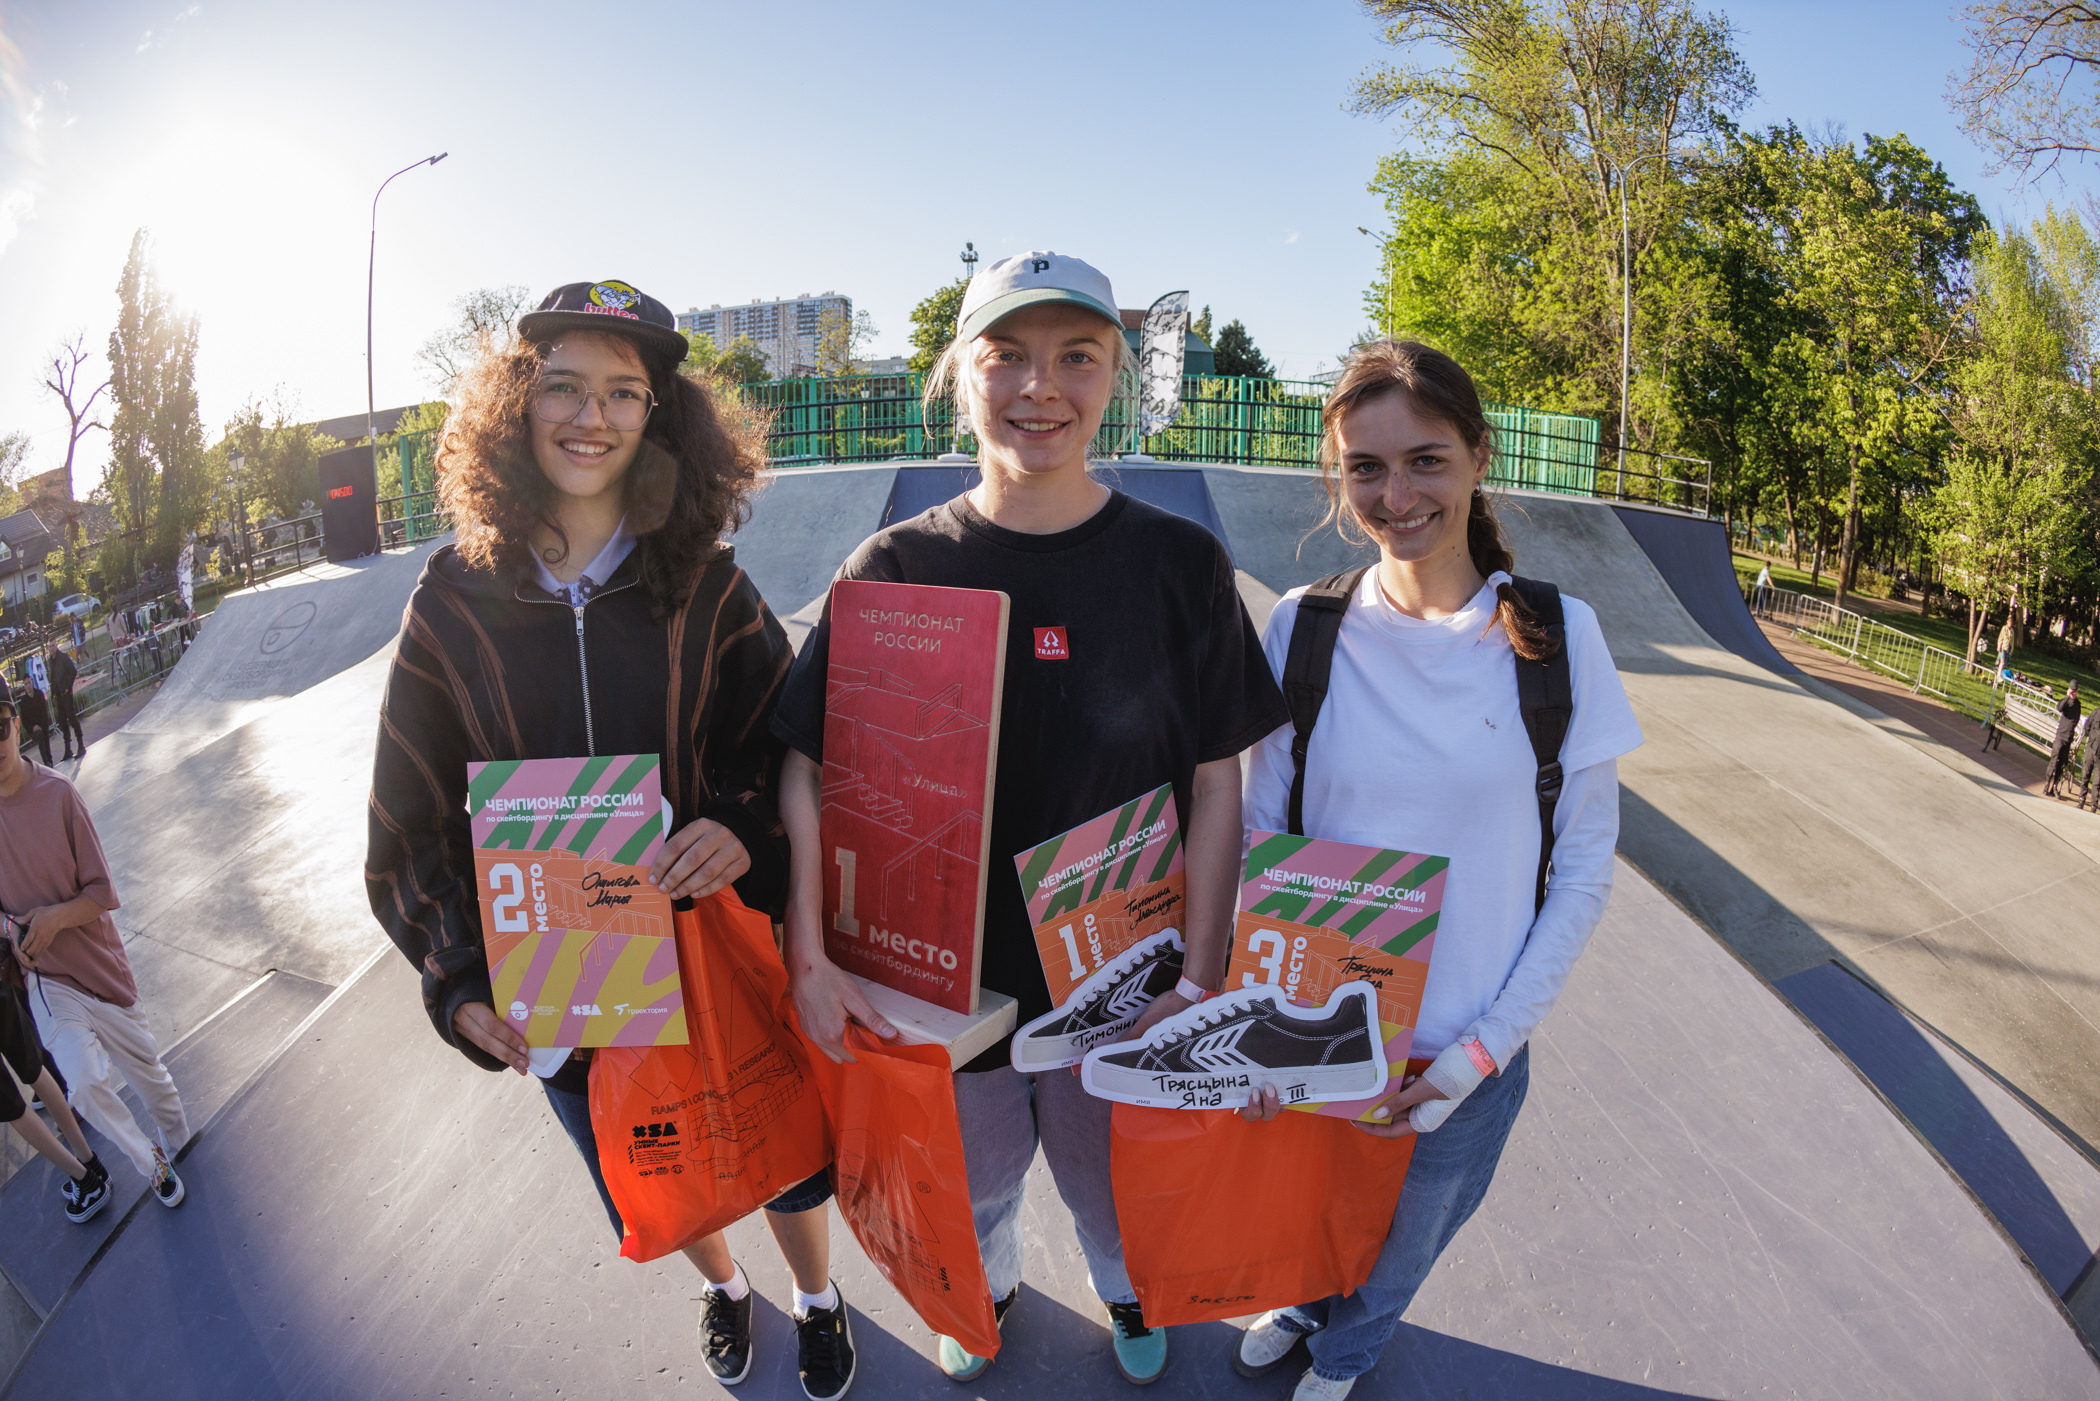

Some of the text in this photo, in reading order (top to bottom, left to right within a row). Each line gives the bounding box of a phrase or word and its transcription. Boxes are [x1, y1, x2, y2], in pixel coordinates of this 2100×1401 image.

[859, 608, 964, 632] ЧЕМПИОНАТ
[874, 632, 941, 653] РОССИИ
[485, 793, 644, 812] ЧЕМПИОНАТ РОССИИ
[903, 773, 967, 798] «Улица»
[496, 814, 552, 823] скейтбордингу
[560, 812, 608, 821] дисциплине
[609, 809, 645, 818] «Улица»
[1038, 819, 1166, 889] ЧЕМПИОНАТ РОССИИ
[1040, 892, 1050, 900] по
[1050, 866, 1099, 896] скейтбордингу
[1104, 846, 1142, 869] дисциплине
[488, 863, 529, 932] 2
[530, 863, 550, 932] место
[586, 889, 632, 908] Мария
[834, 846, 860, 938] 1
[1263, 867, 1427, 903] ЧЕМПИОНАТ РОССИИ
[1271, 885, 1332, 902] скейтбордингу
[1339, 896, 1388, 909] дисциплине
[1389, 902, 1424, 913] «Улица»
[869, 924, 957, 970] место
[1058, 923, 1087, 981] 1
[1084, 913, 1105, 969] место
[1242, 928, 1286, 989] 3
[850, 945, 954, 991] скейтбордингу
[1285, 936, 1307, 1000] место
[627, 1007, 668, 1015] траектория
[650, 1100, 688, 1115] RAMPS
